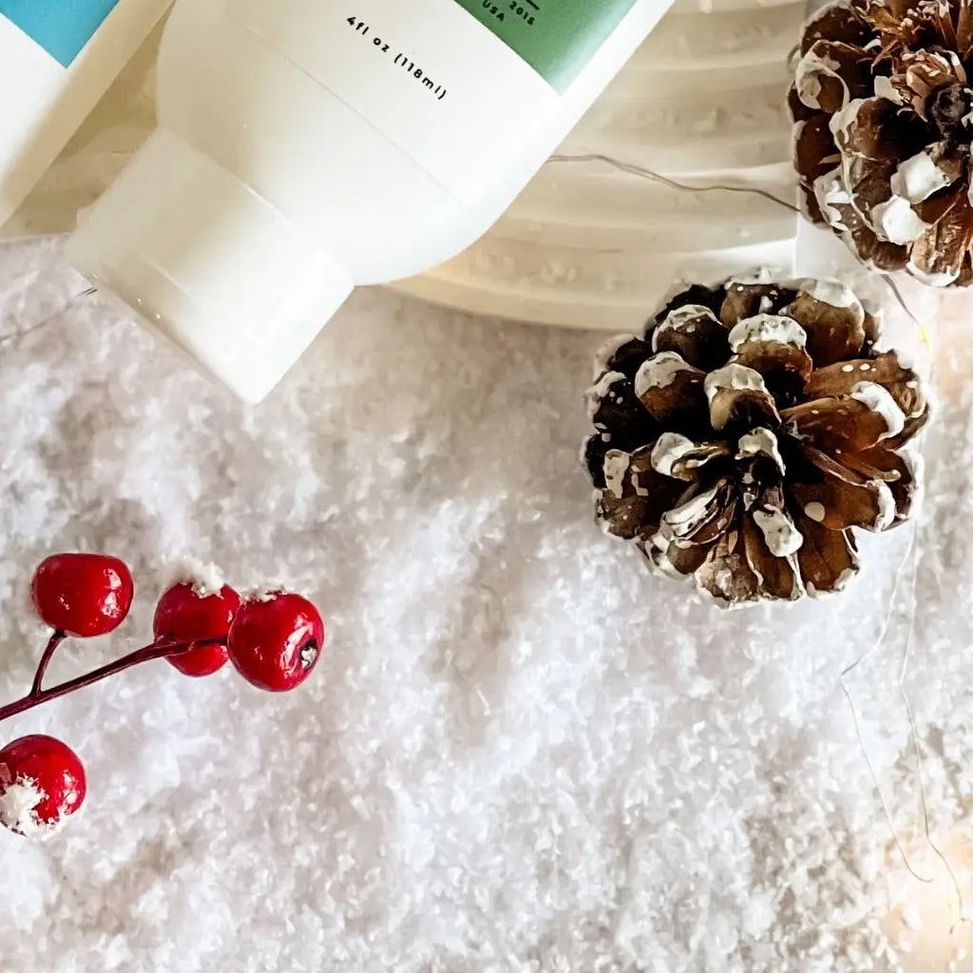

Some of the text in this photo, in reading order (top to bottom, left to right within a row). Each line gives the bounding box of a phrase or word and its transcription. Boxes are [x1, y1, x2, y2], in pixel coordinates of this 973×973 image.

[482, 1, 505, 22] USA
[509, 1, 536, 25] 2015
[346, 15, 447, 100] 4fl oz (118ml)
